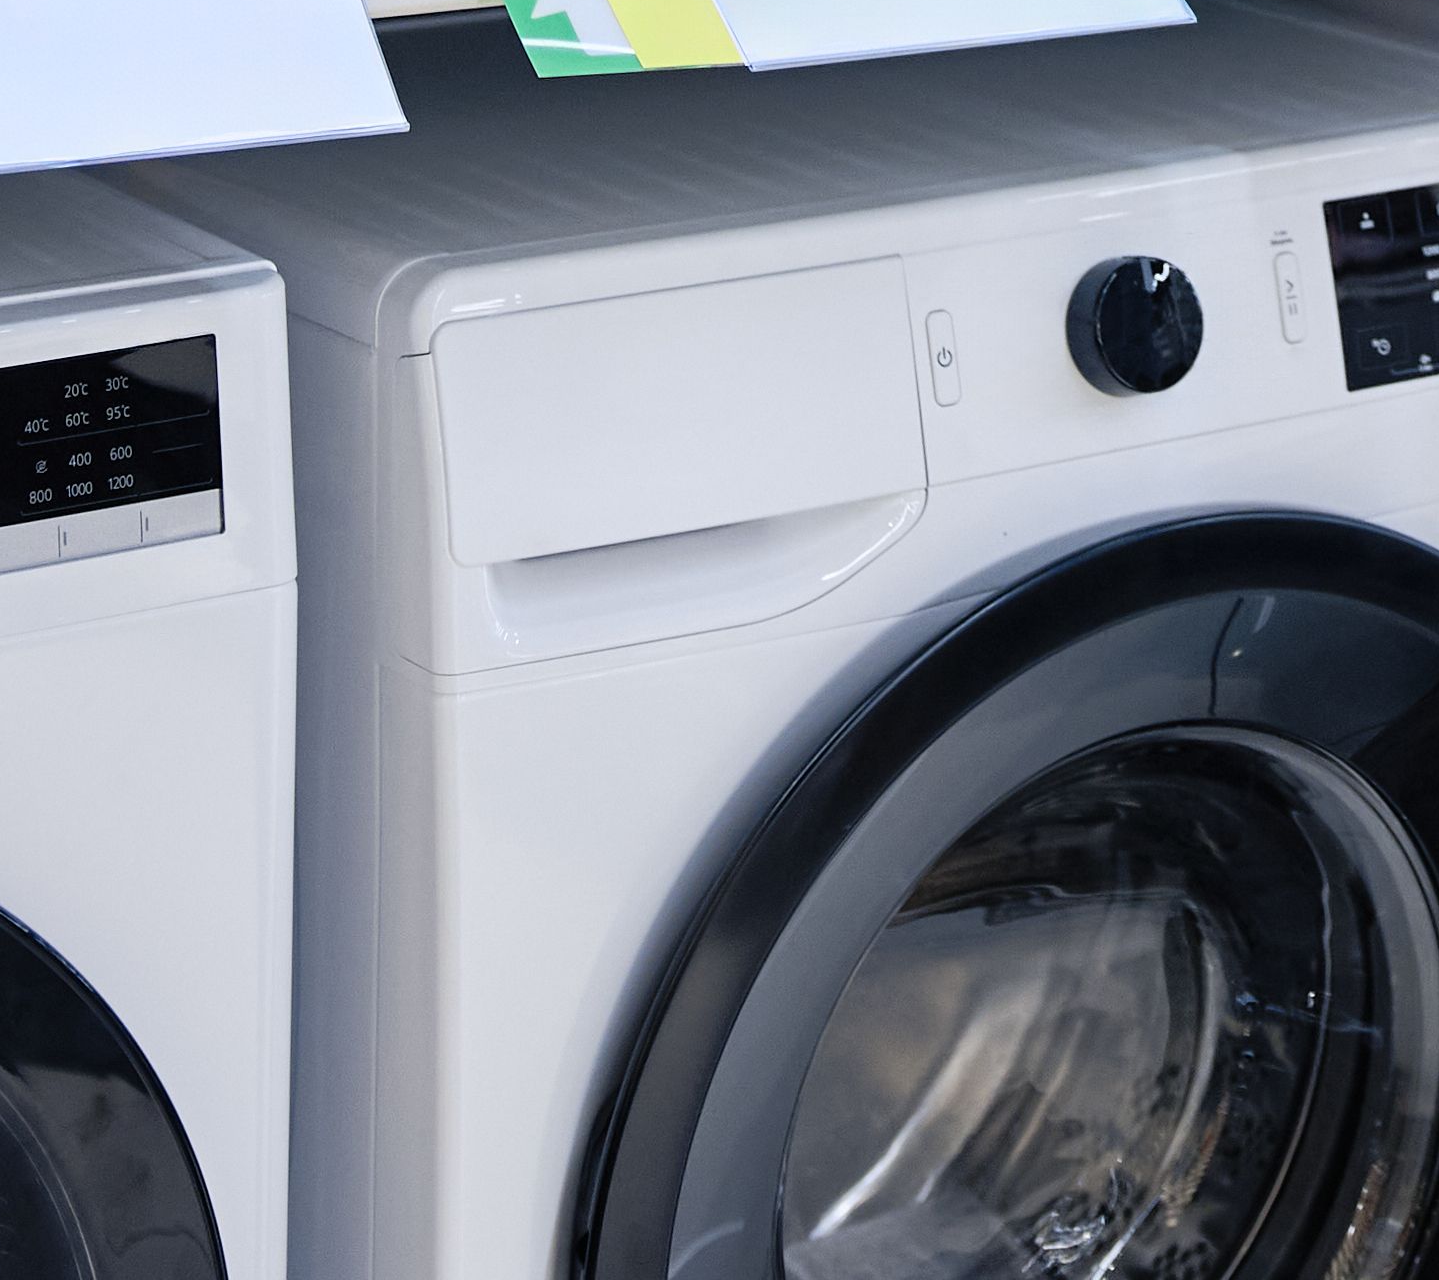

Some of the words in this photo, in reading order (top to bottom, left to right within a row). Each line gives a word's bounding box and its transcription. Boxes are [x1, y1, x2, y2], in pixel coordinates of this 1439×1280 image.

[64, 382, 89, 399] 20°C
[105, 375, 129, 392] 30°C
[24, 418, 50, 434] 40°C
[65, 411, 90, 428] 60°C
[106, 404, 131, 421] 95°C
[68, 451, 92, 467] 400
[110, 445, 133, 461] 600
[29, 488, 53, 505] 800
[65, 481, 93, 498] 1000
[108, 474, 134, 491] 1200
